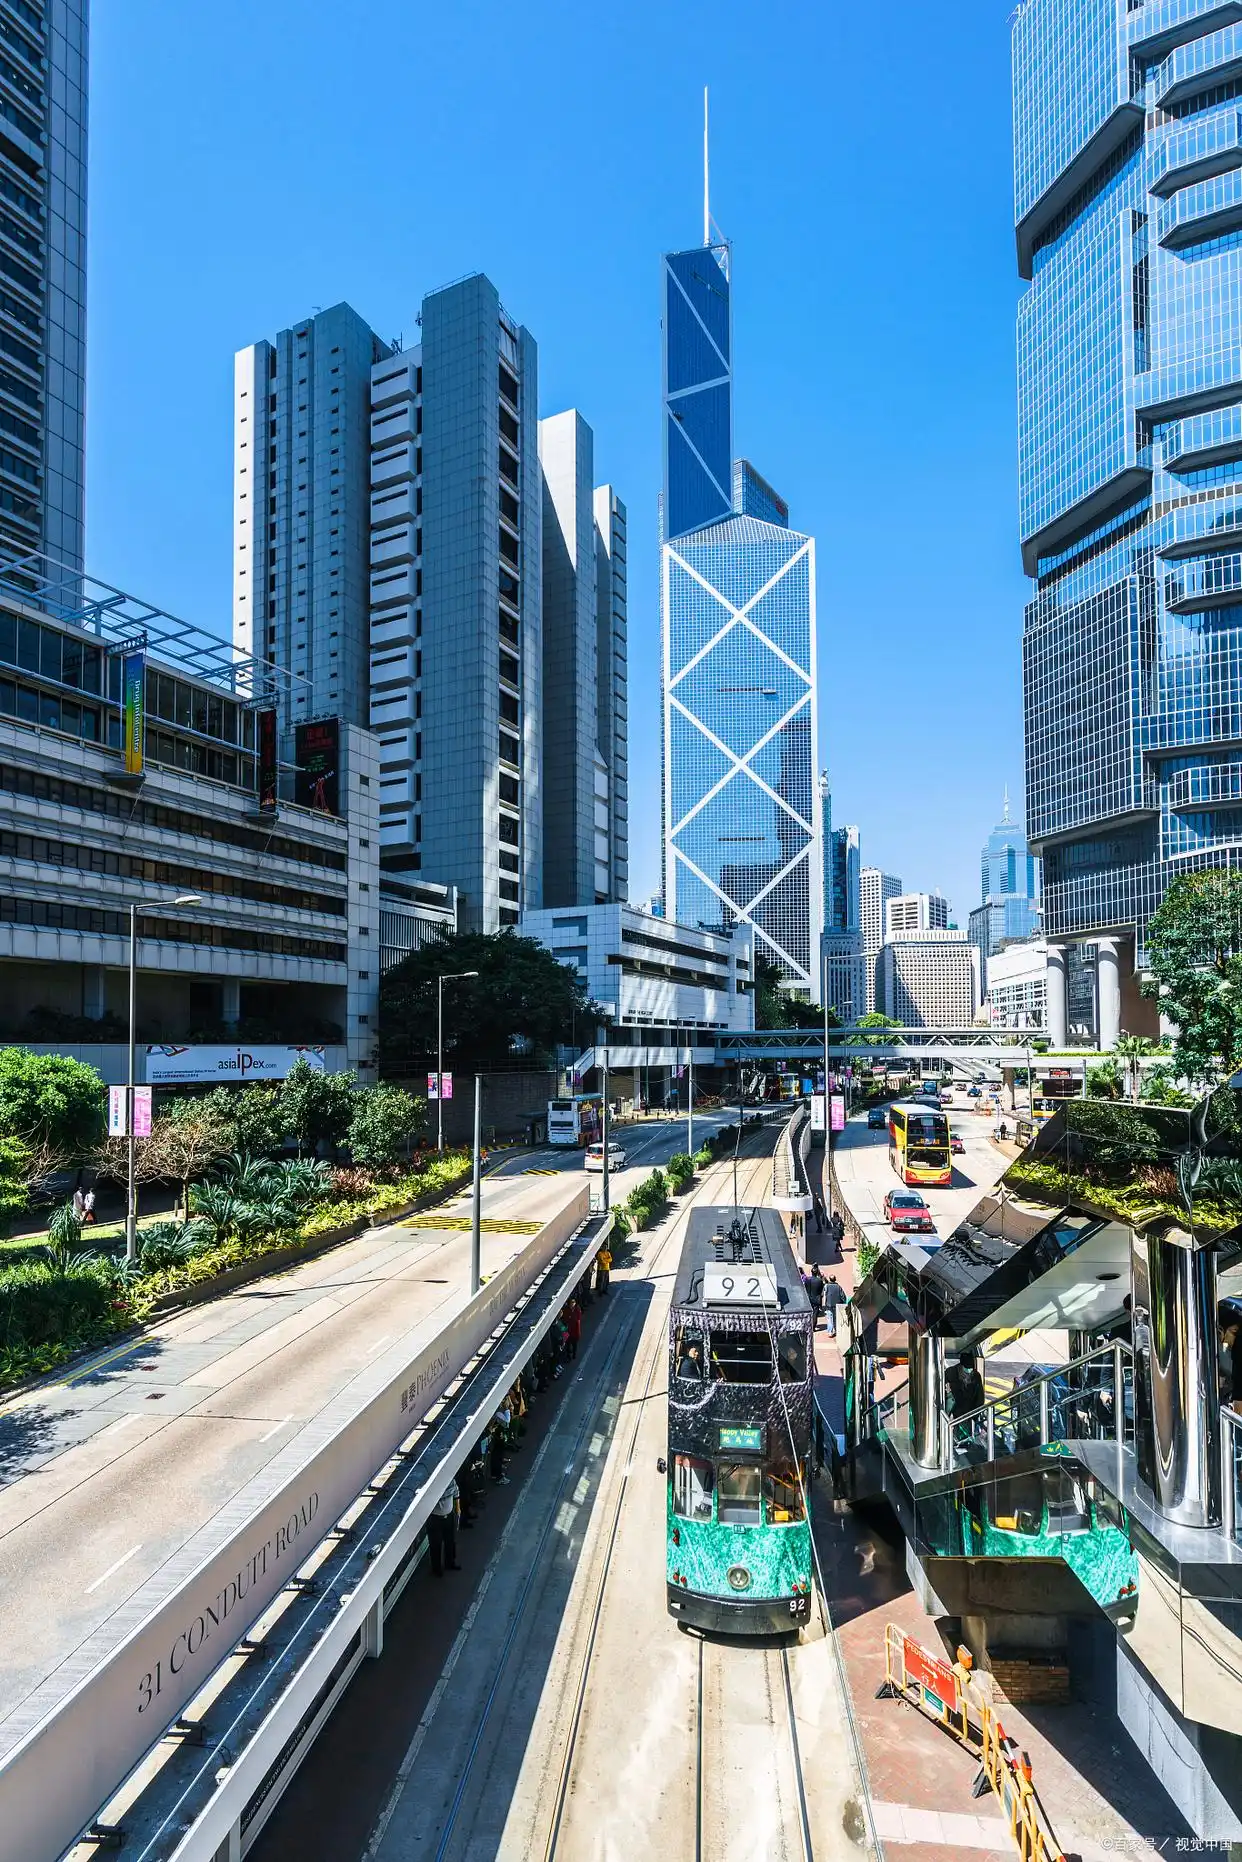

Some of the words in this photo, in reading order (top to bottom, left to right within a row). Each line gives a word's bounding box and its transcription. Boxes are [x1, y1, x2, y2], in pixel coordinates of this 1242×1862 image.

[721, 1277, 761, 1297] 92
[680, 1315, 693, 1326] 92
[789, 1319, 804, 1331] 92
[138, 1661, 162, 1714] 31
[169, 1541, 271, 1674] CONDUIT
[275, 1492, 319, 1560] ROAD
[789, 1599, 806, 1612] 92
[905, 1641, 952, 1682] PEDESTRIANS
[921, 1671, 940, 1695] 行人
